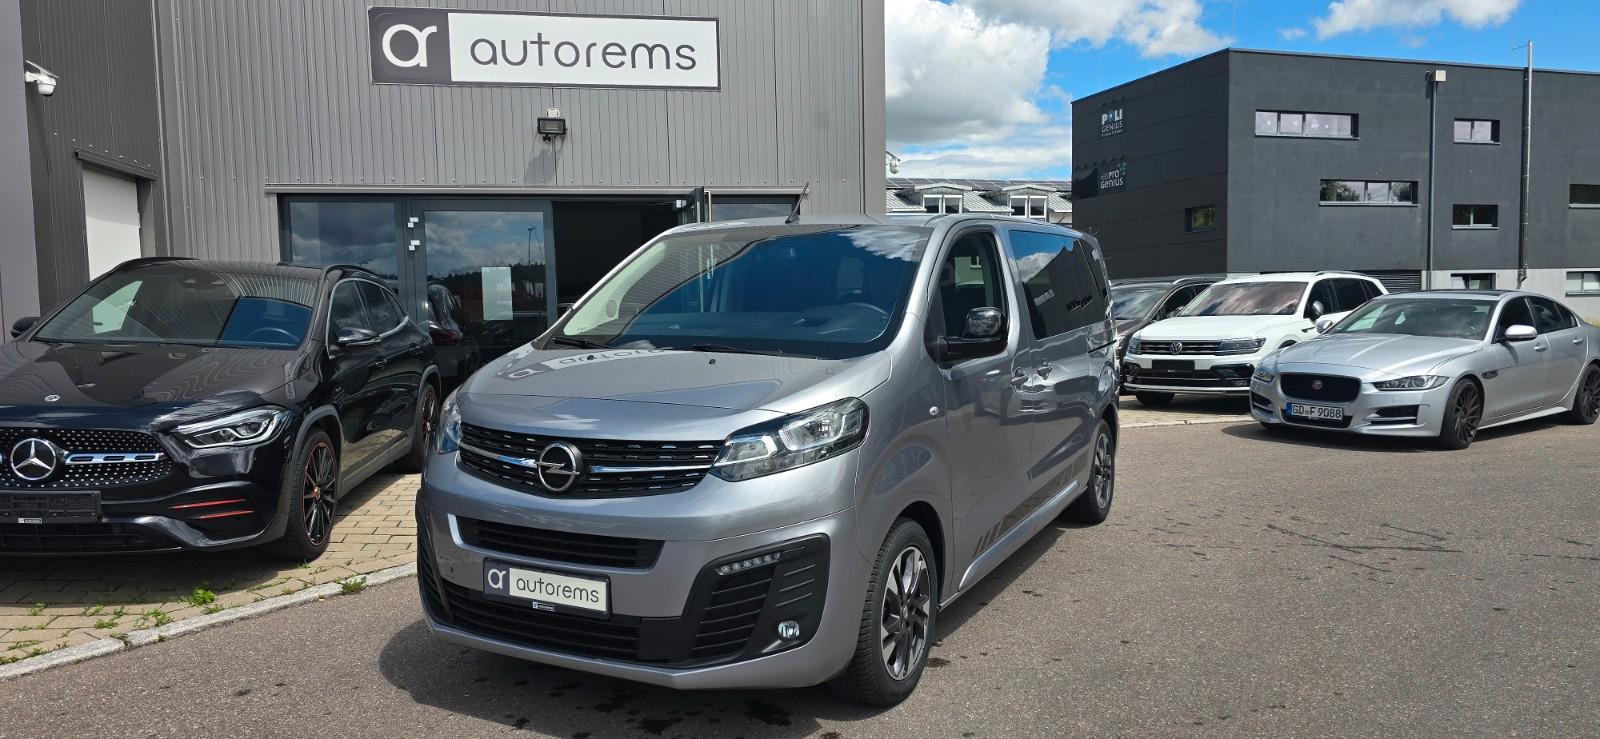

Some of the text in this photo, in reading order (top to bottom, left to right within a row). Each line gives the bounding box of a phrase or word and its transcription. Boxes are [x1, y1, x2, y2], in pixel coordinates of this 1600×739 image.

[470, 32, 697, 70] autorems
[1293, 404, 1341, 418] GD F 9088
[516, 577, 599, 603] autorems
